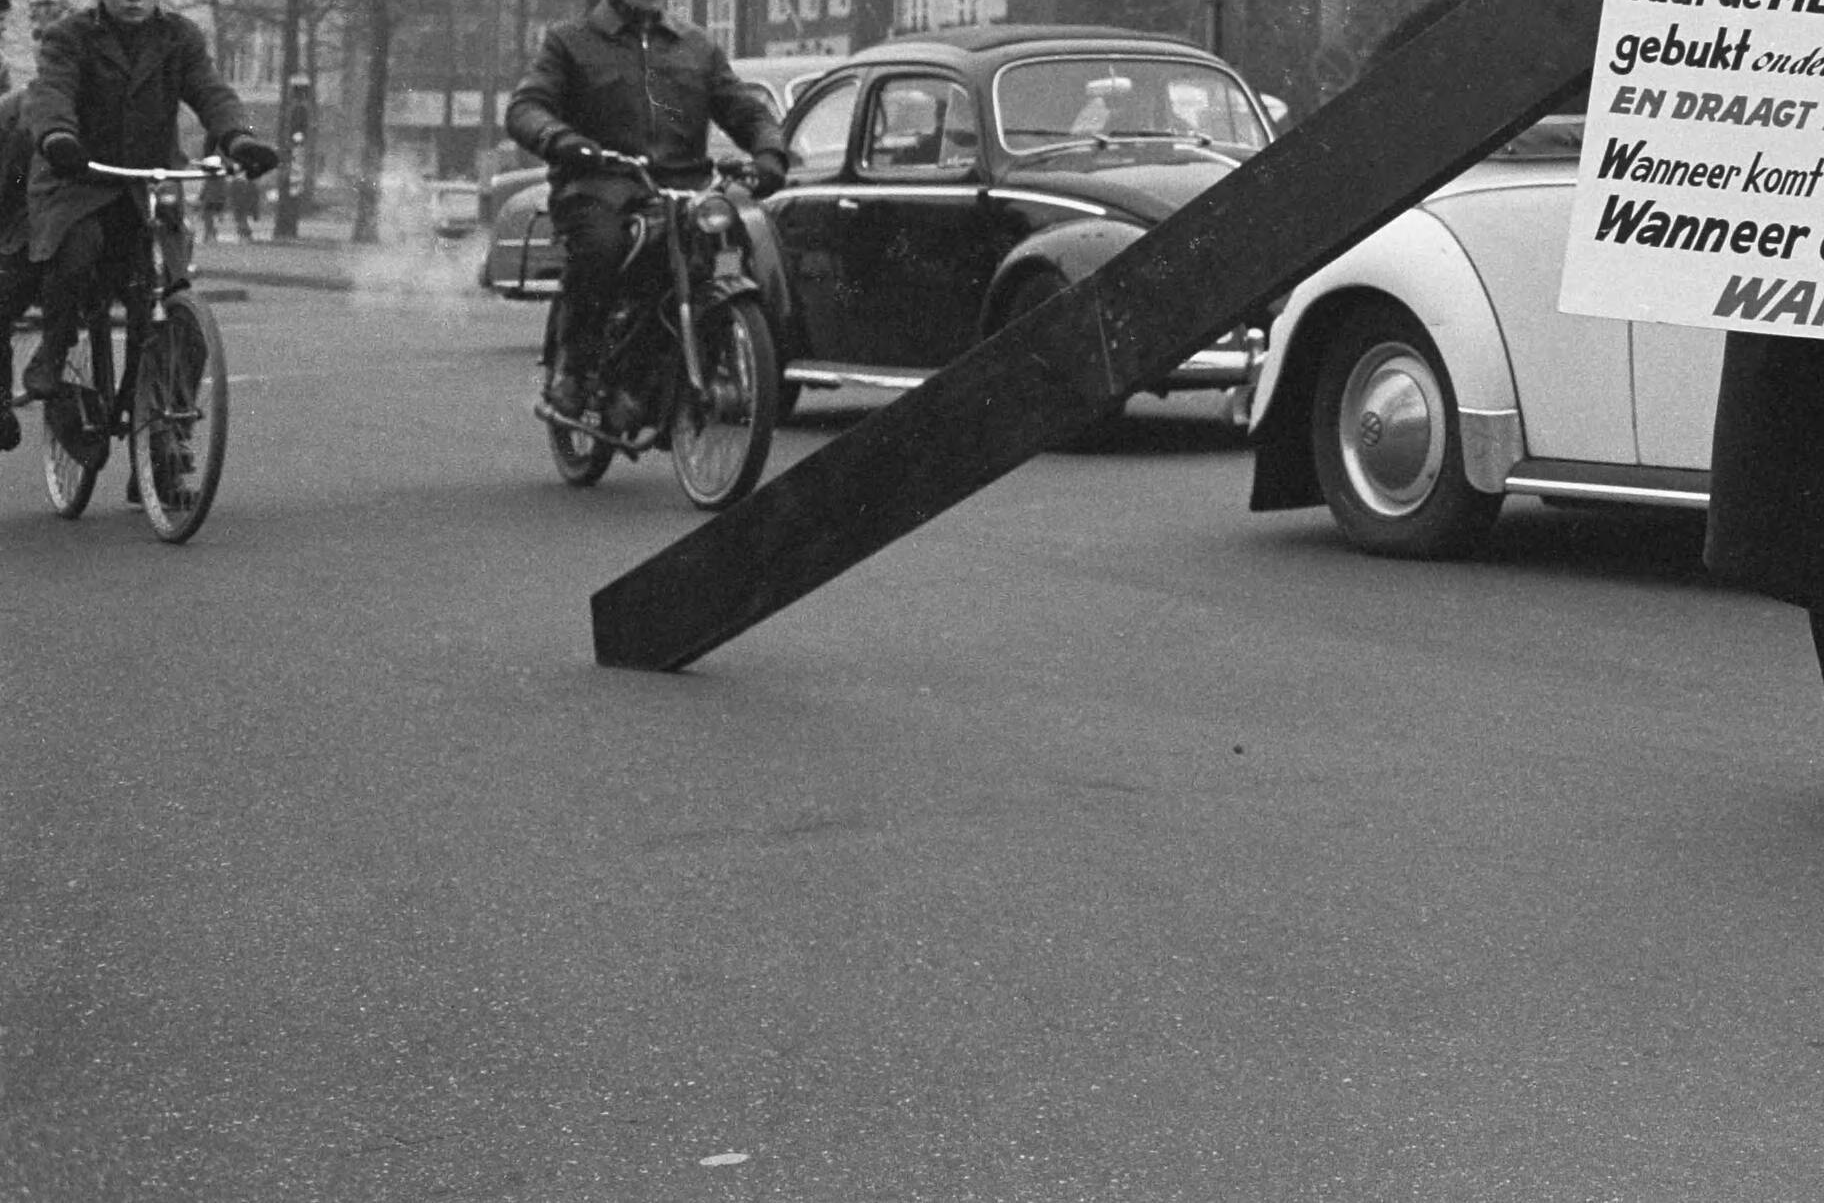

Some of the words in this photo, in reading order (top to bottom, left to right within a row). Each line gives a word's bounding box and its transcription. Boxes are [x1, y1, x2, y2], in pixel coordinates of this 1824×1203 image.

[1609, 23, 1752, 75] gebukt
[1609, 86, 1667, 118] EN
[1671, 91, 1818, 129] DRAAGT
[1597, 138, 1741, 189] Wanneer
[1741, 152, 1824, 197] komt
[1595, 195, 1811, 259] Wanneer
